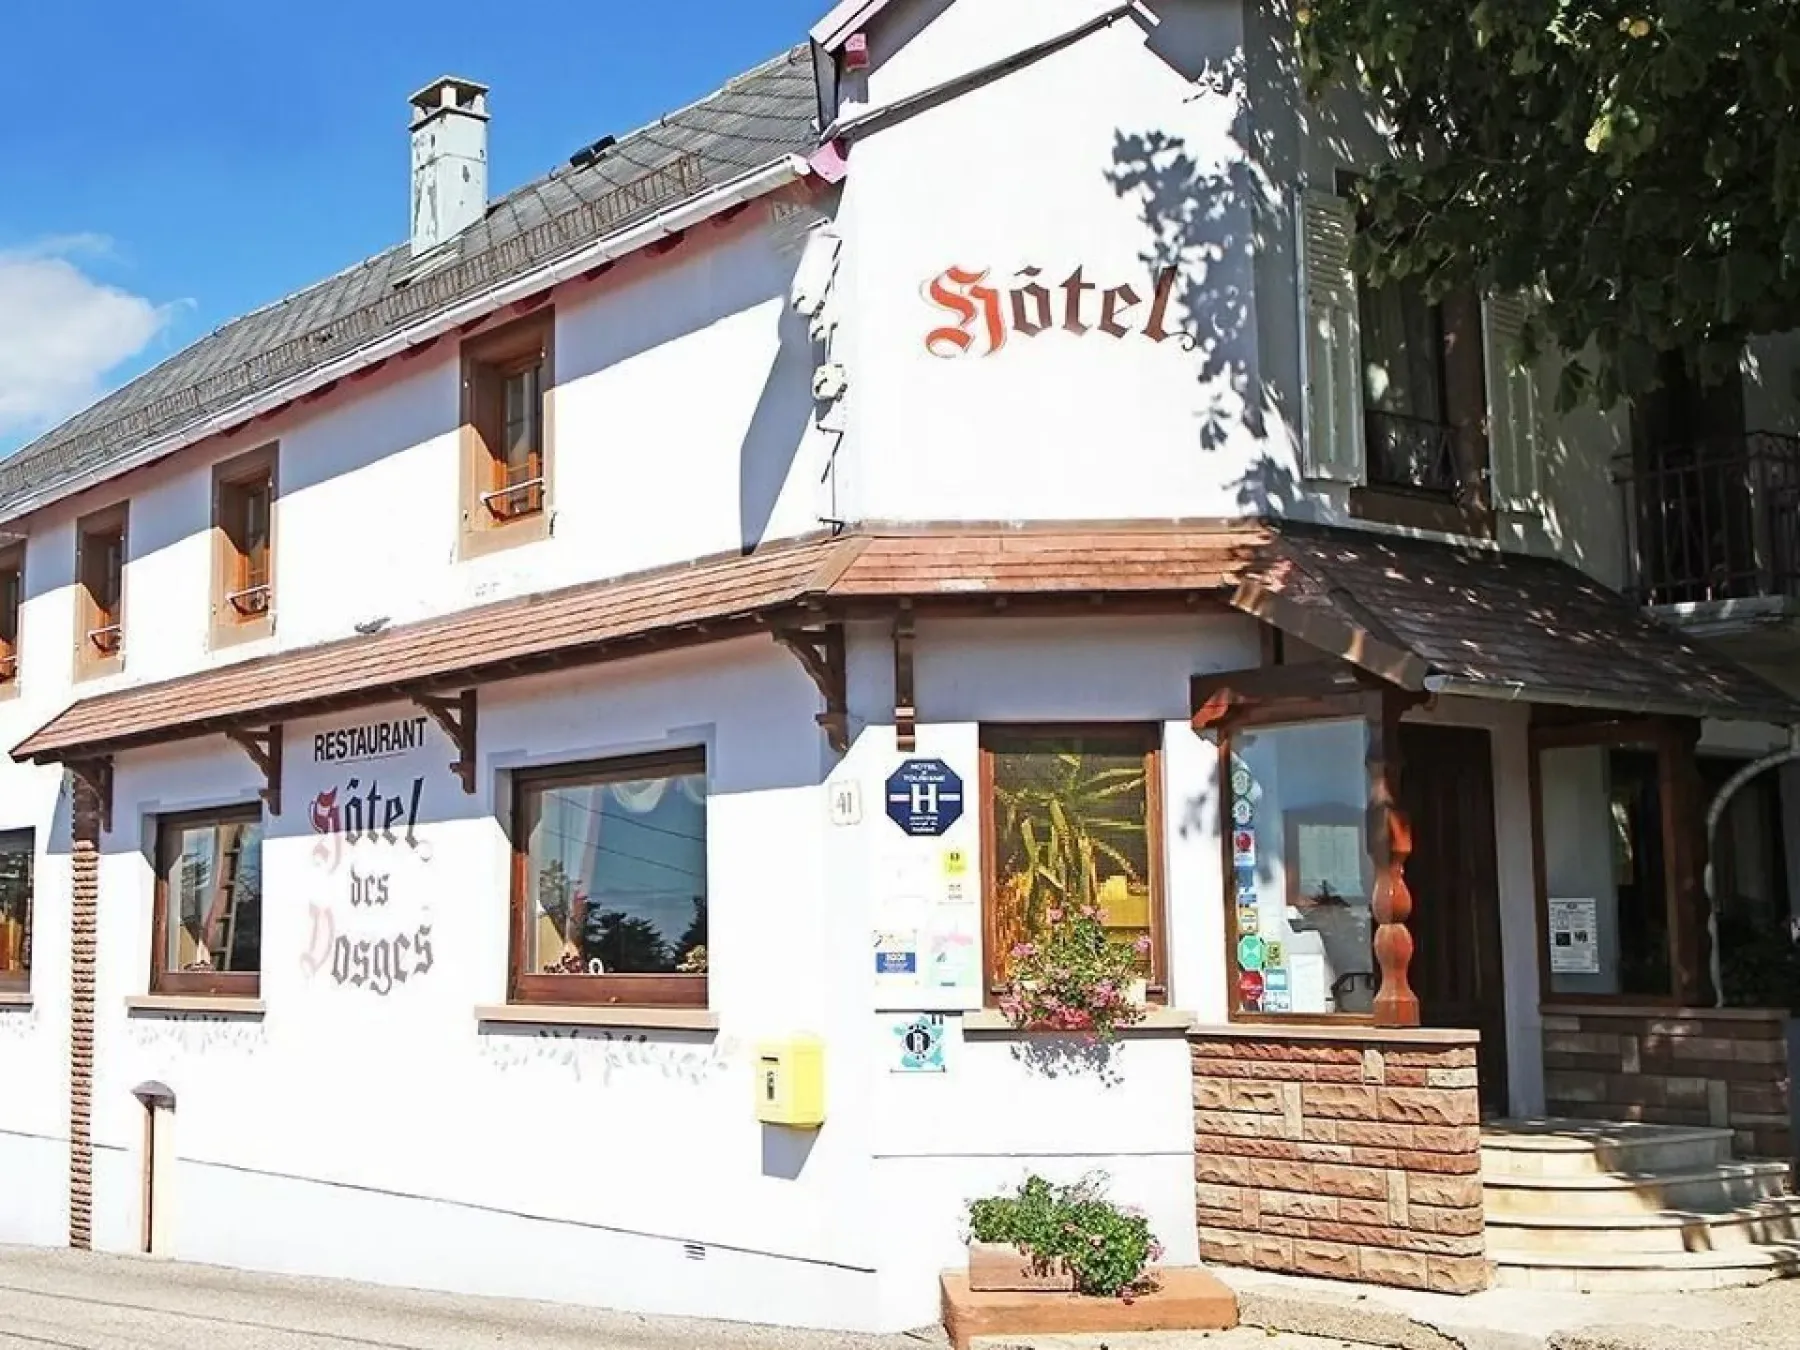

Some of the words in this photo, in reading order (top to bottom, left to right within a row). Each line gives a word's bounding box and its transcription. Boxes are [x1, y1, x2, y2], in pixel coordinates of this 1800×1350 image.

[919, 264, 1197, 358] Hôtel
[314, 717, 428, 762] RESTAURANT
[309, 776, 432, 874] Hôtel
[910, 783, 938, 813] H
[350, 864, 391, 907] des
[300, 900, 434, 996] Vosges
